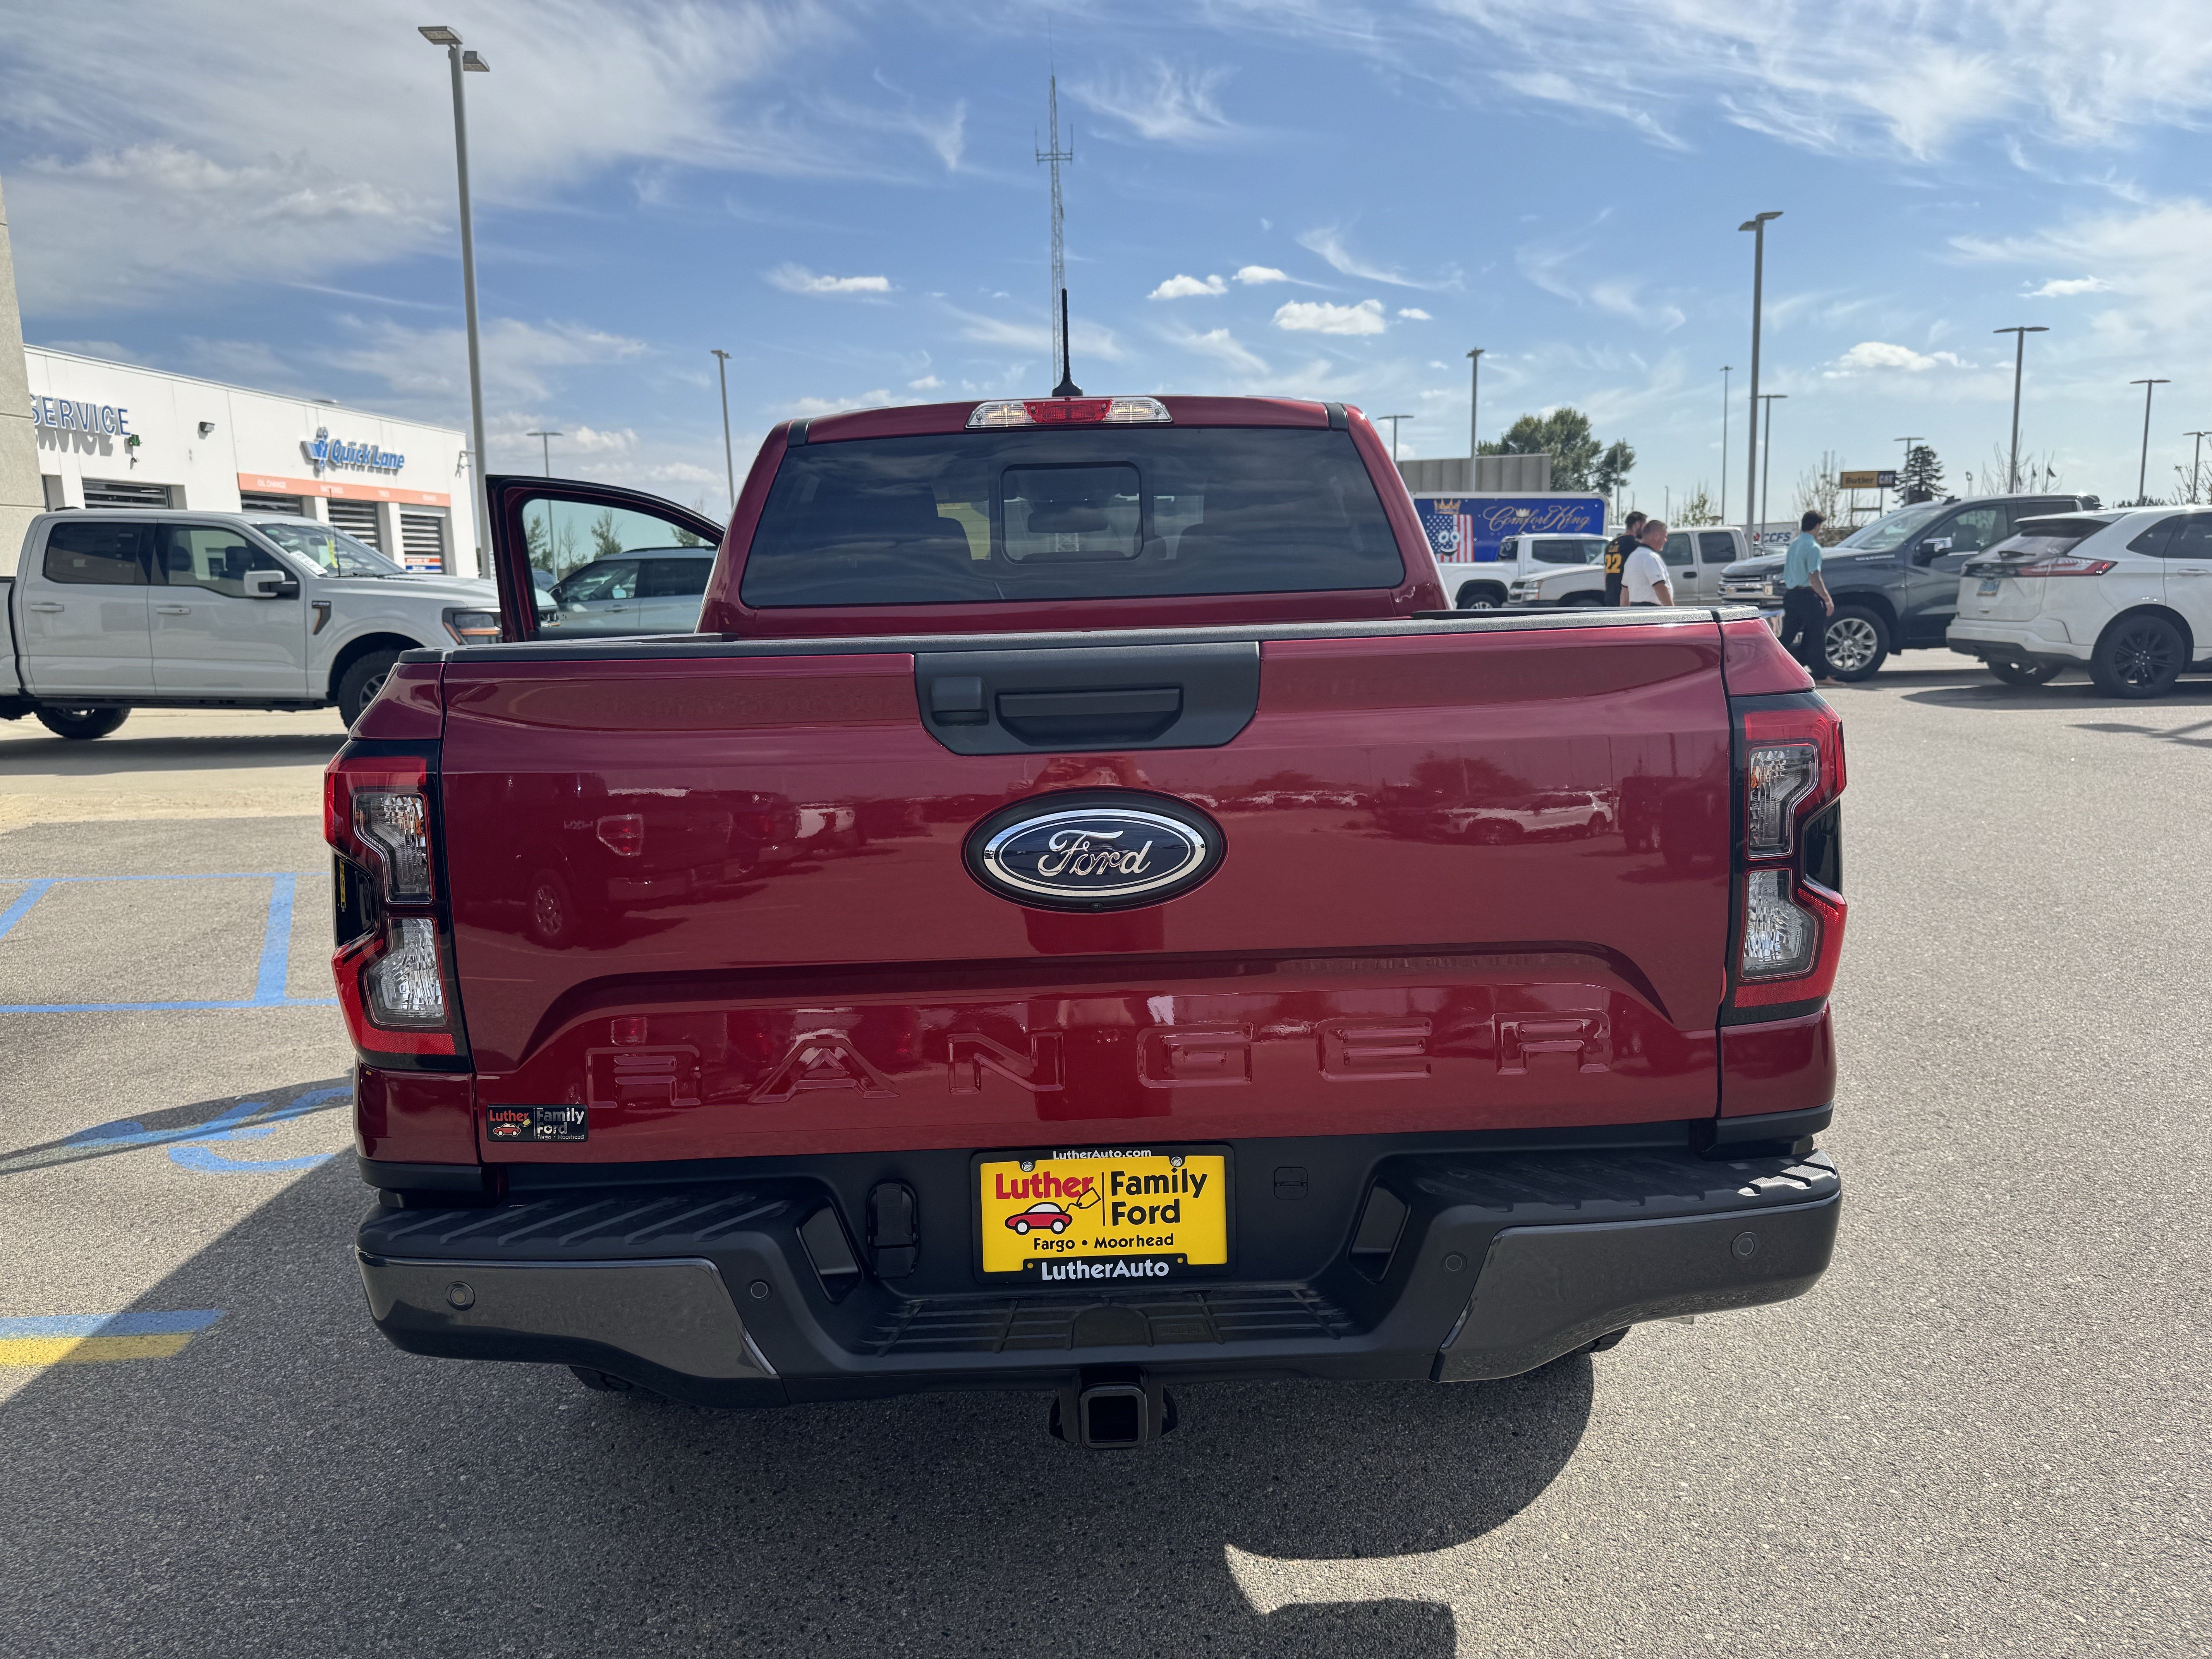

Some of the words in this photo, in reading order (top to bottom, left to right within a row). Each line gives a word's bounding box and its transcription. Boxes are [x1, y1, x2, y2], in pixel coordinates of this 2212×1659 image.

[1878, 474, 1894, 484] CAT
[1483, 505, 1549, 532] Comfort
[1532, 505, 1591, 532] King
[1605, 554, 1622, 574] 22
[1037, 830, 1153, 877] Ford
[586, 1009, 1612, 1109] RANGER
[489, 1110, 529, 1122] Luther
[536, 1107, 584, 1125] Family
[537, 1121, 567, 1134] Ford
[1053, 1148, 1151, 1160] LutherAuto.com
[996, 1171, 1094, 1200] Luther
[1111, 1168, 1208, 1198] Family
[1112, 1199, 1181, 1226] Ford
[1034, 1237, 1075, 1252] Fargo
[1094, 1233, 1174, 1249] Moorhead
[1042, 1259, 1169, 1281] LutherAuto
